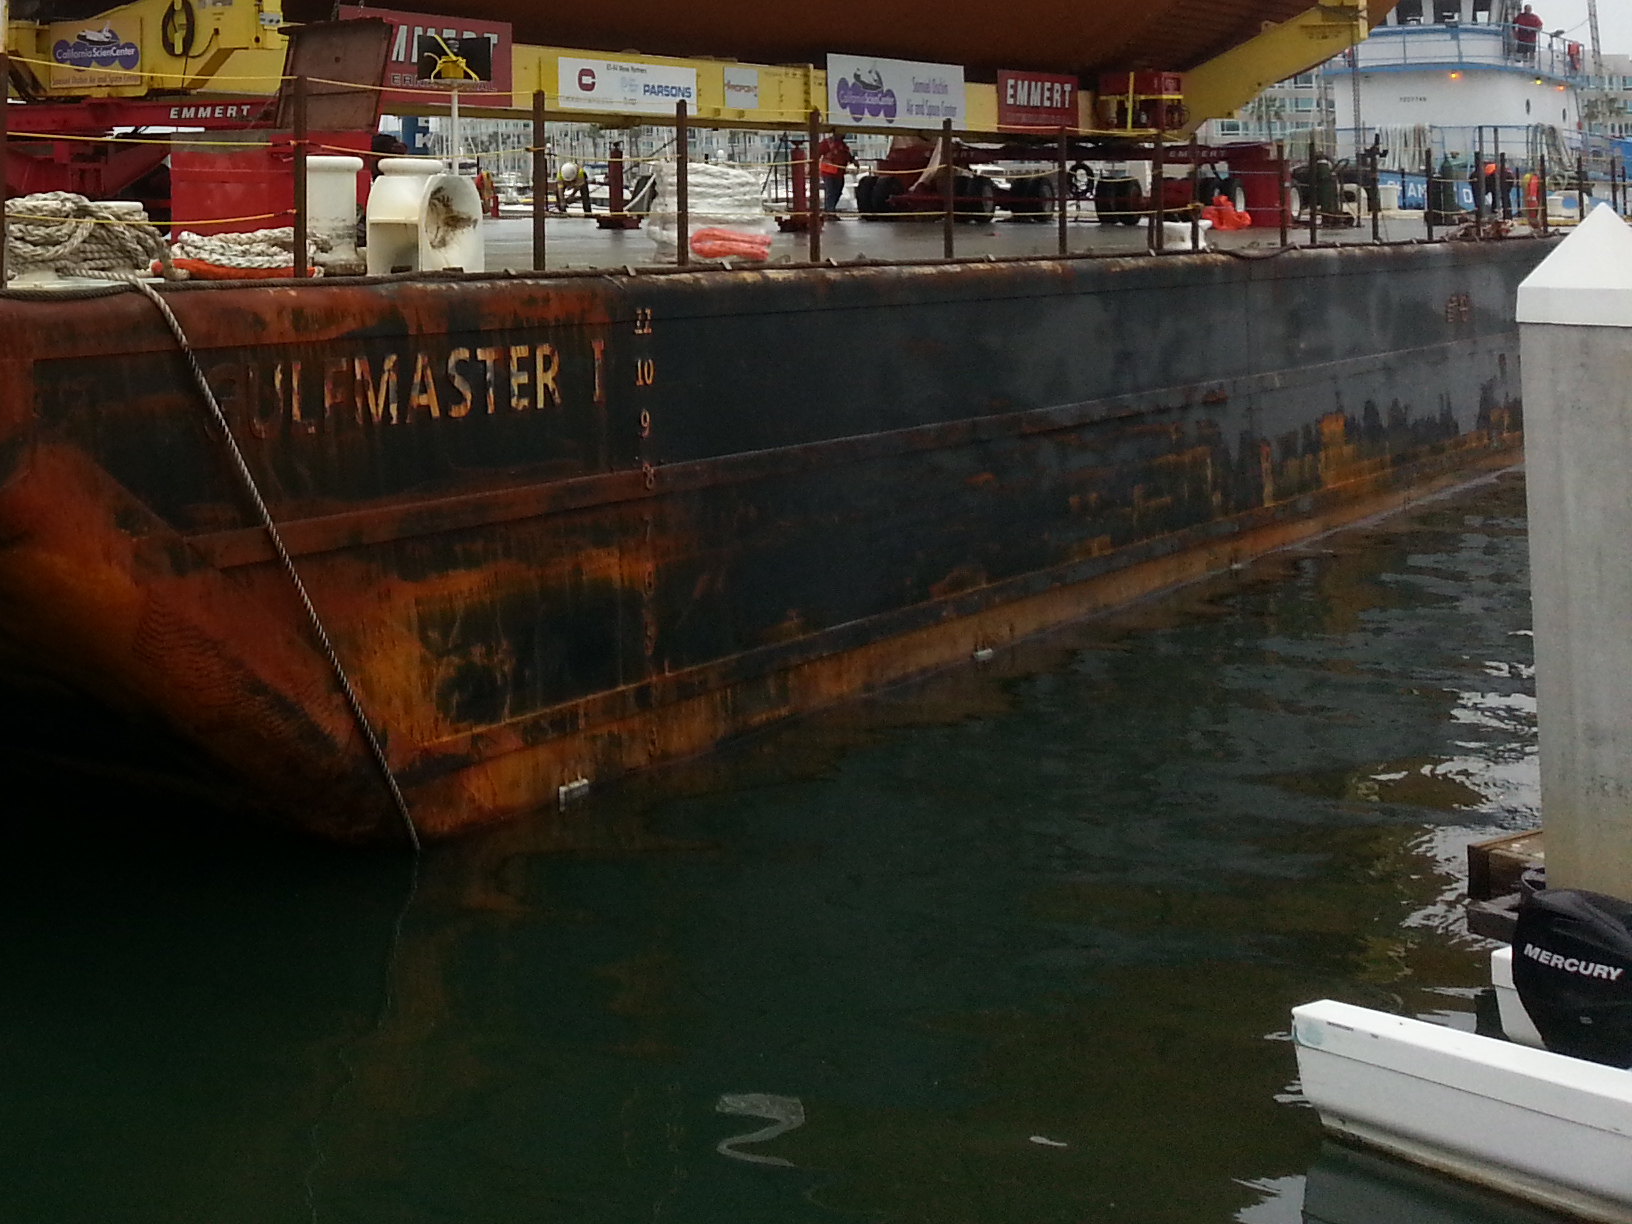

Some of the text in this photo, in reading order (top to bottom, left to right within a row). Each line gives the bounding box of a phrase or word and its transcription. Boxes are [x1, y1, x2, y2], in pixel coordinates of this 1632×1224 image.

[643, 84, 692, 98] PARSONS
[1006, 79, 1072, 108] EMMERT
[170, 105, 251, 119] EMMERT
[635, 358, 655, 386] 10
[639, 408, 651, 439] 9
[1523, 943, 1624, 981] MERCURY
